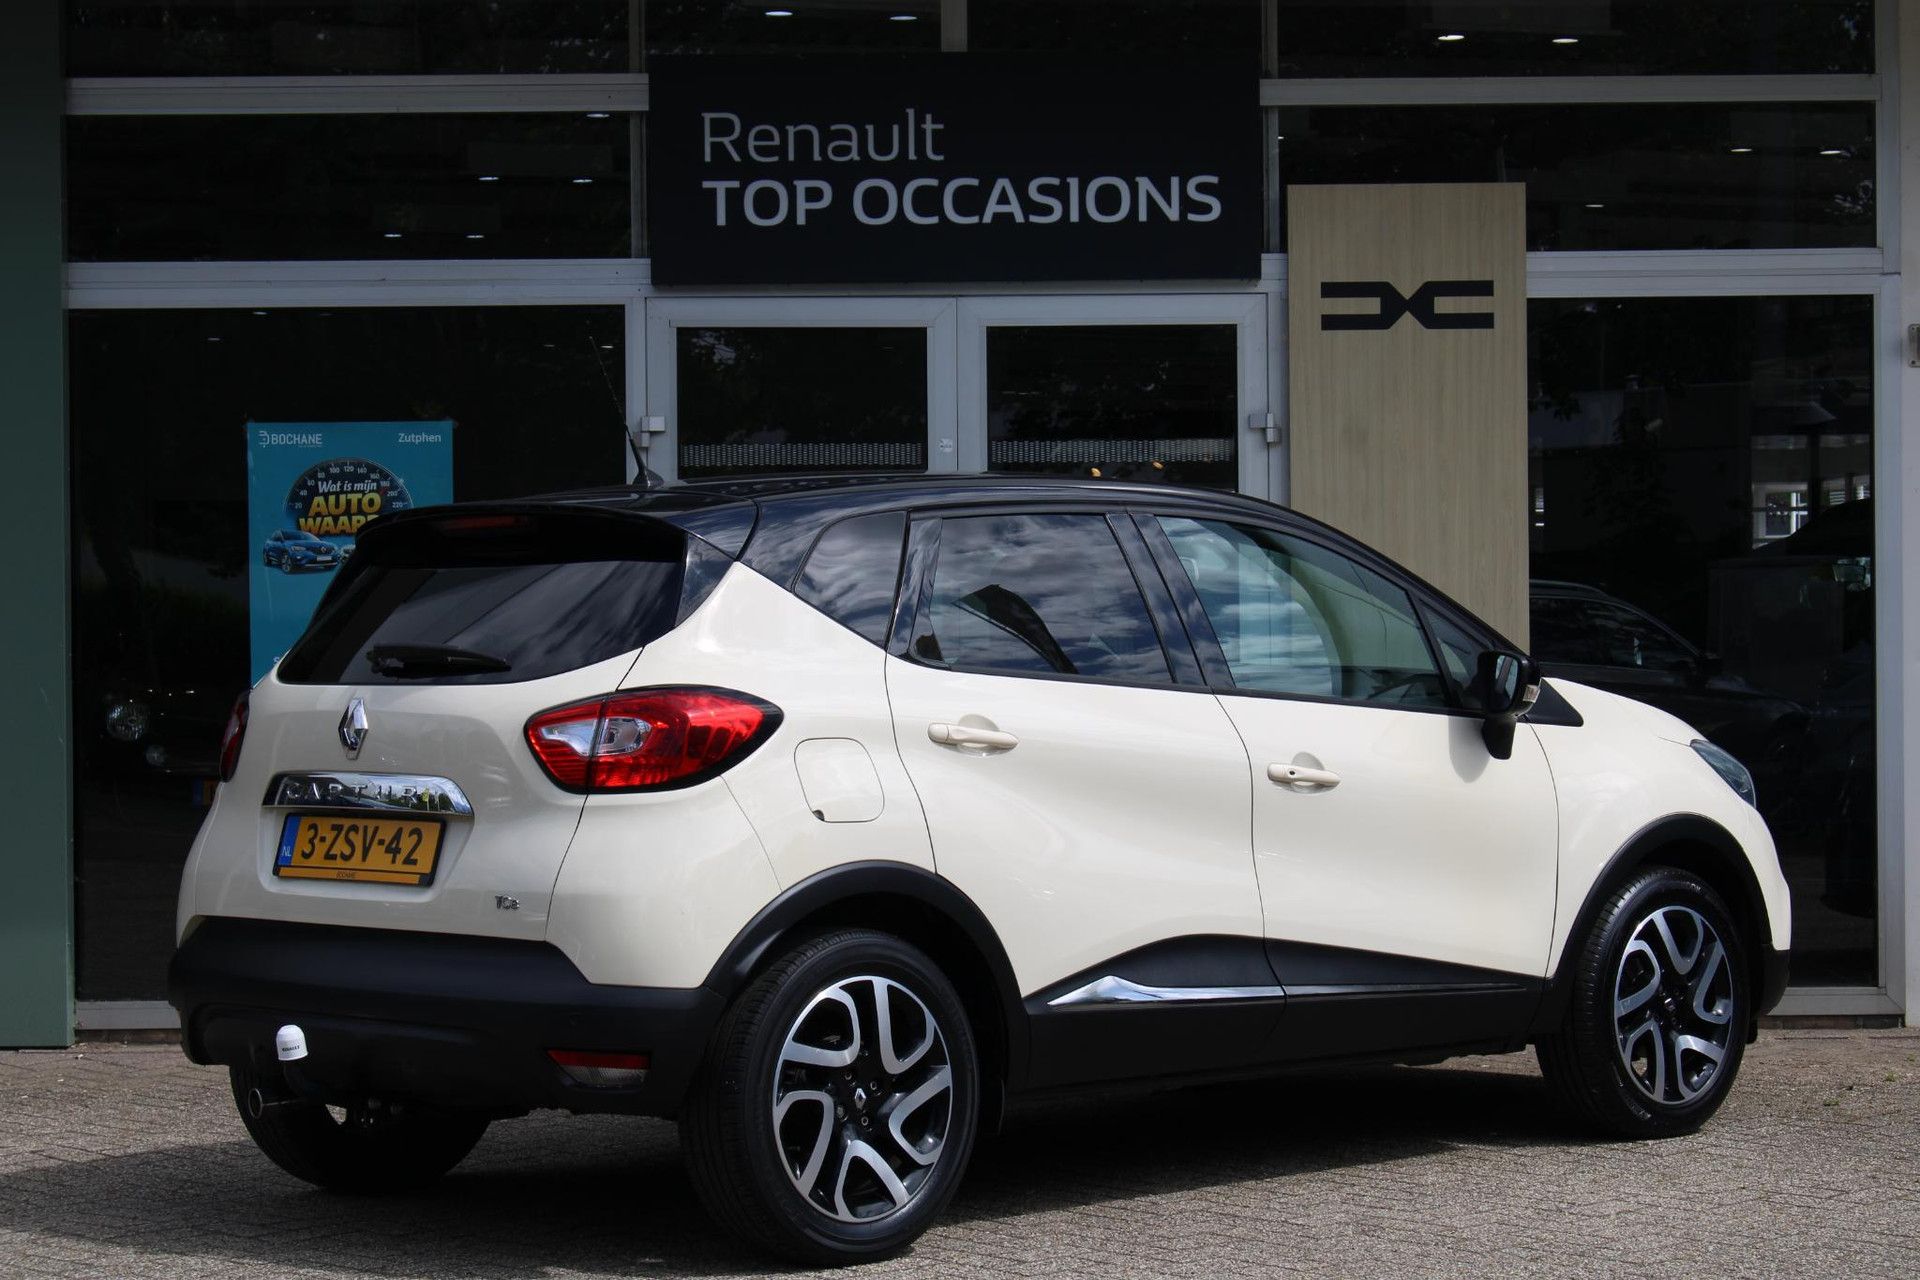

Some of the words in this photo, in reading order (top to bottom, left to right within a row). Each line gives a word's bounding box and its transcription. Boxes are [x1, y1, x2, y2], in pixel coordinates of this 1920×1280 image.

[701, 108, 944, 163] Renault
[701, 179, 833, 227] TOP
[852, 174, 1222, 226] OCCASIONS
[271, 433, 322, 445] BOCHANE
[398, 432, 442, 446] Zutphen
[317, 480, 341, 493] Wat
[344, 480, 352, 492] is
[354, 480, 377, 494] mijn
[308, 492, 382, 517] AUTO
[281, 845, 292, 857] NL
[301, 822, 424, 866] 3-ZSV-42
